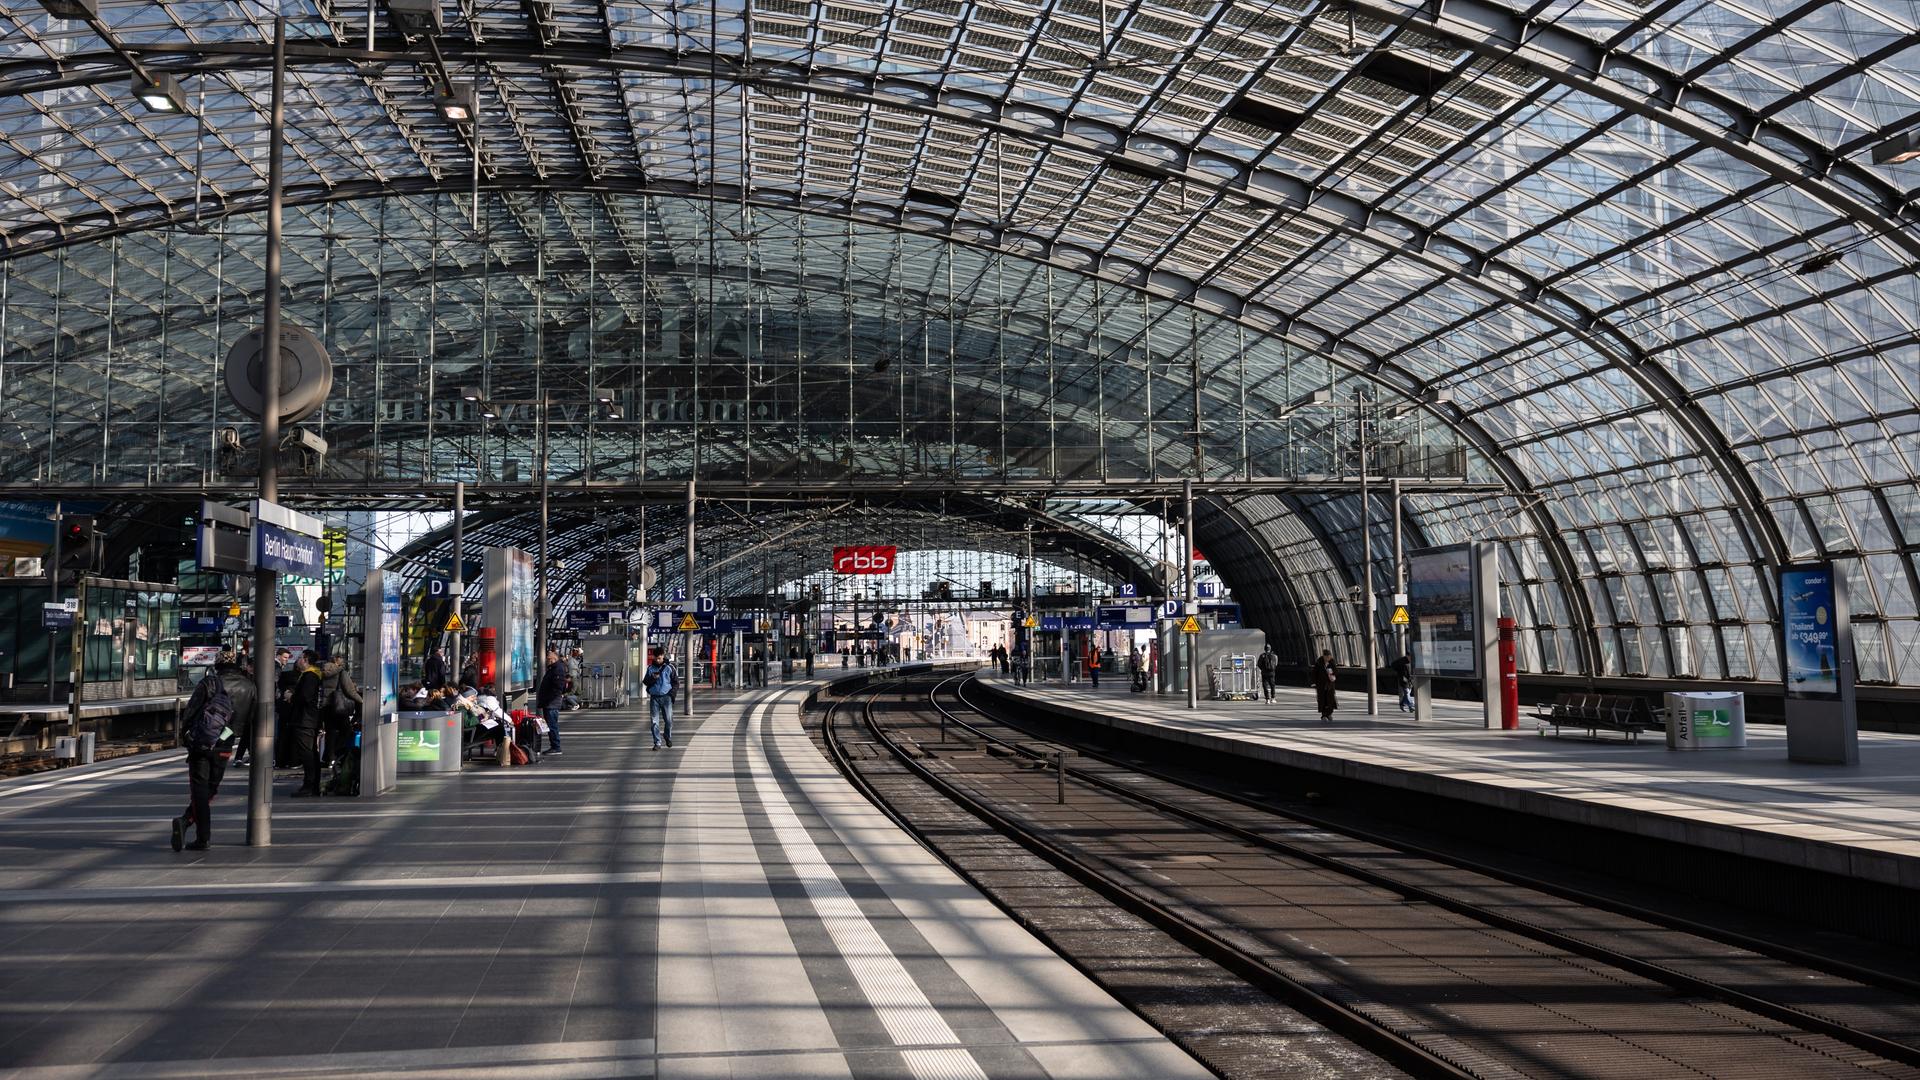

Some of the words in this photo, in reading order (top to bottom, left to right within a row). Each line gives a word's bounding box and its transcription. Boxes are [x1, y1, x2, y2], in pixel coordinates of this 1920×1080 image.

[265, 534, 281, 557] Berlin
[281, 538, 313, 566] Hauptbahnhof
[839, 552, 888, 569] rbb
[431, 580, 442, 594] D
[1805, 577, 1822, 585] condor
[593, 588, 606, 600] 14
[1121, 584, 1134, 595] 12
[1203, 583, 1214, 594] 11
[66, 601, 77, 609] 318
[703, 598, 714, 612] D
[1166, 601, 1177, 615] D
[1791, 622, 1815, 631] Thailand
[1791, 632, 1799, 640] ab
[1678, 709, 1689, 741] Abfall
